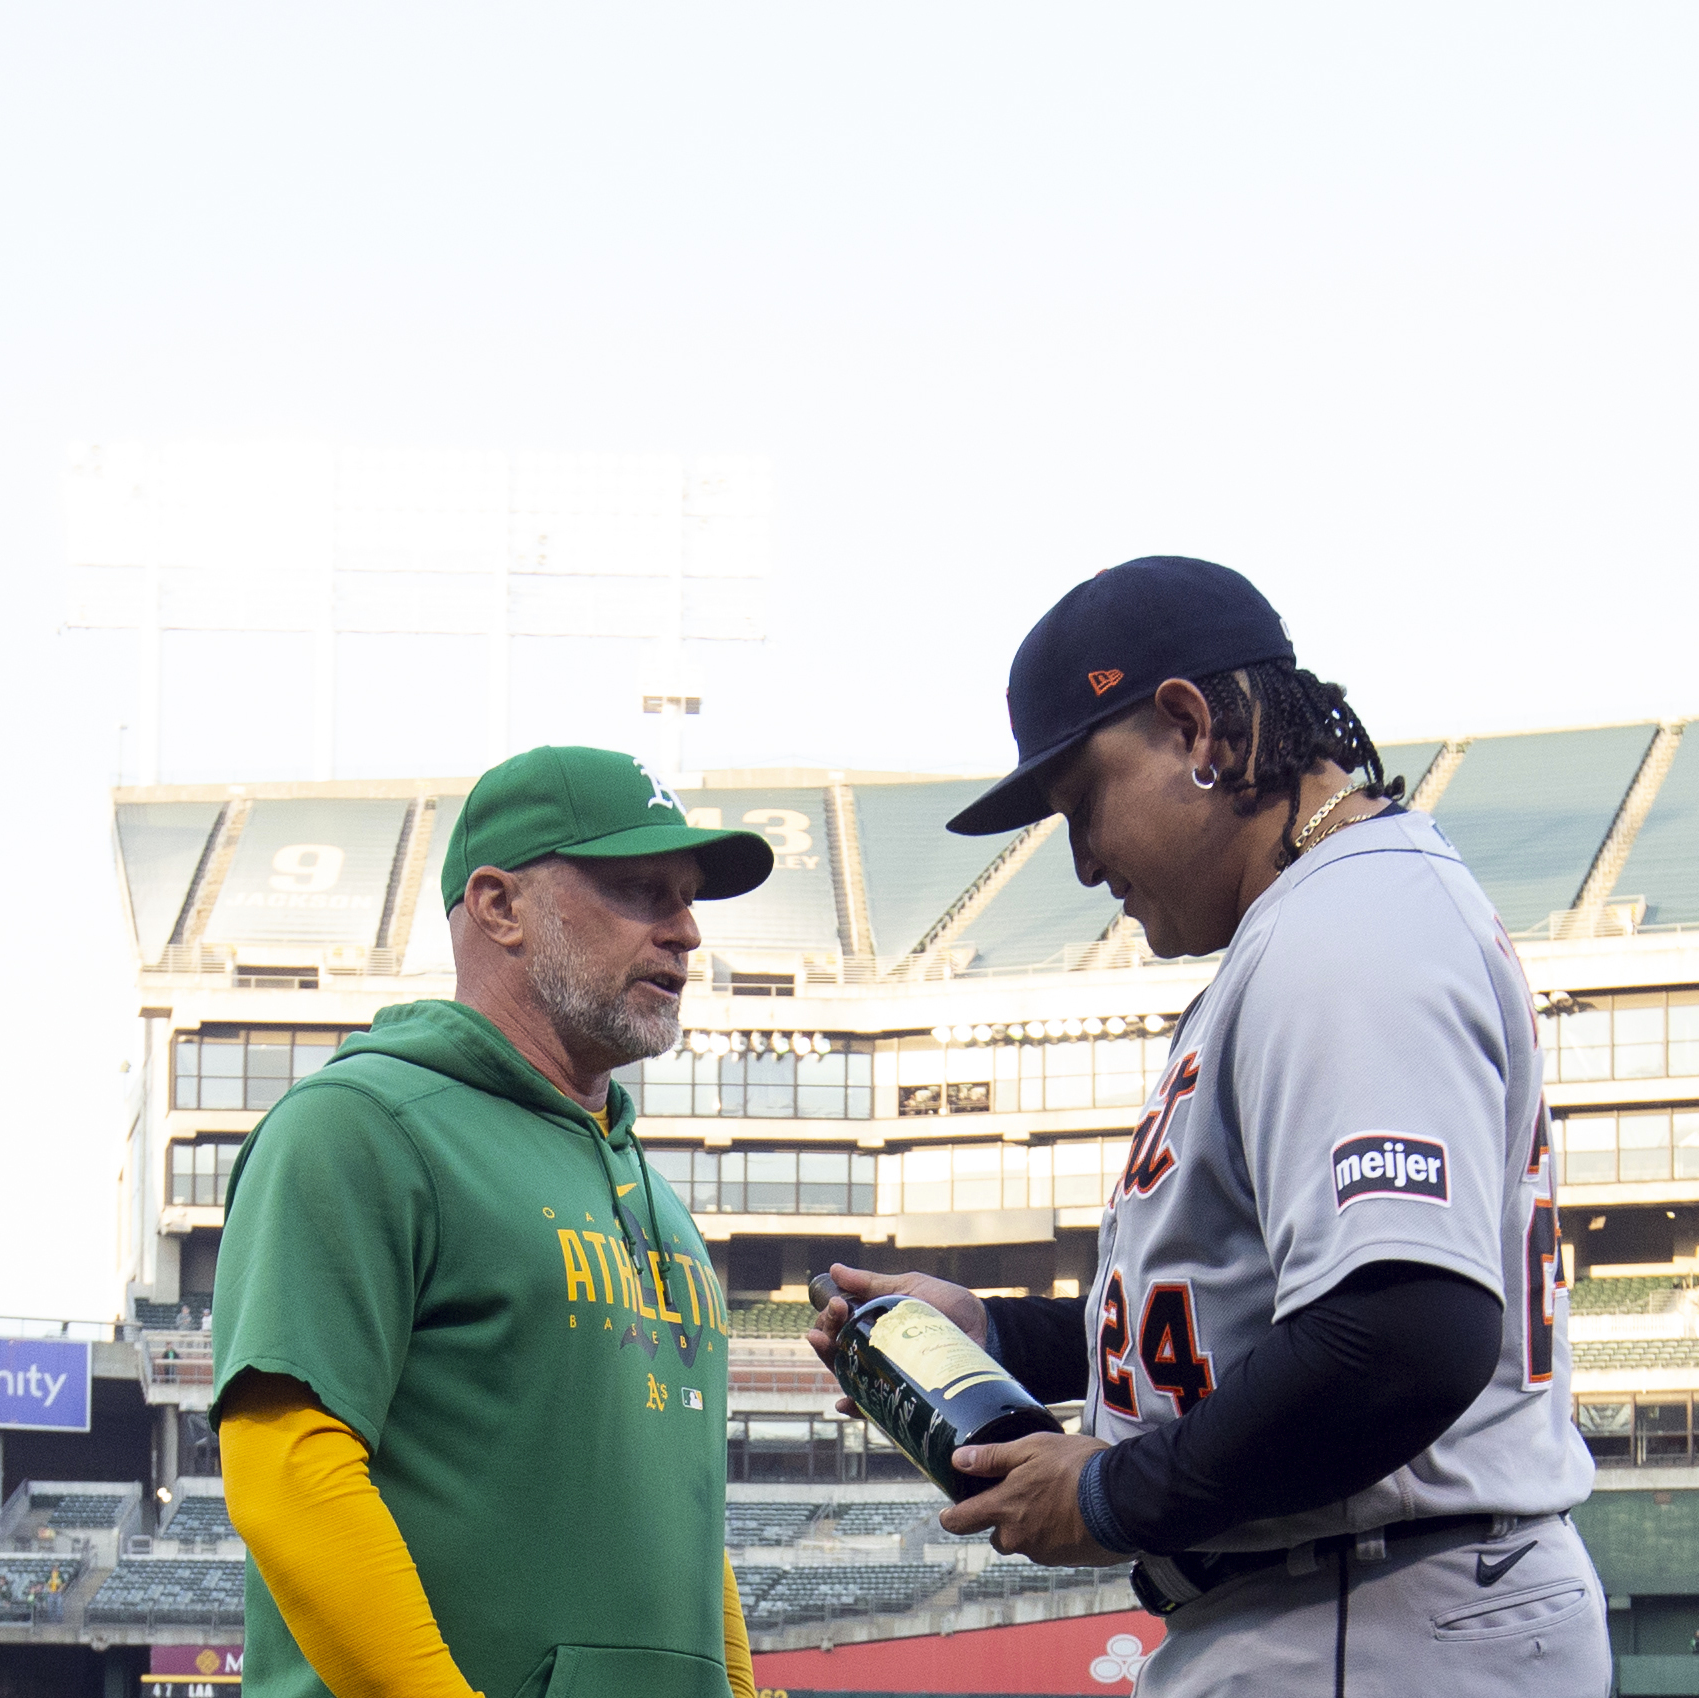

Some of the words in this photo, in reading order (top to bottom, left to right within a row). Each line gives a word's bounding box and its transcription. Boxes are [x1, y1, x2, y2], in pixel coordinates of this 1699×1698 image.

[267, 843, 345, 893] 9
[1335, 1140, 1442, 1187] meijer
[1098, 1264, 1219, 1422] 24
[188, 1682, 215, 1698] LAA
